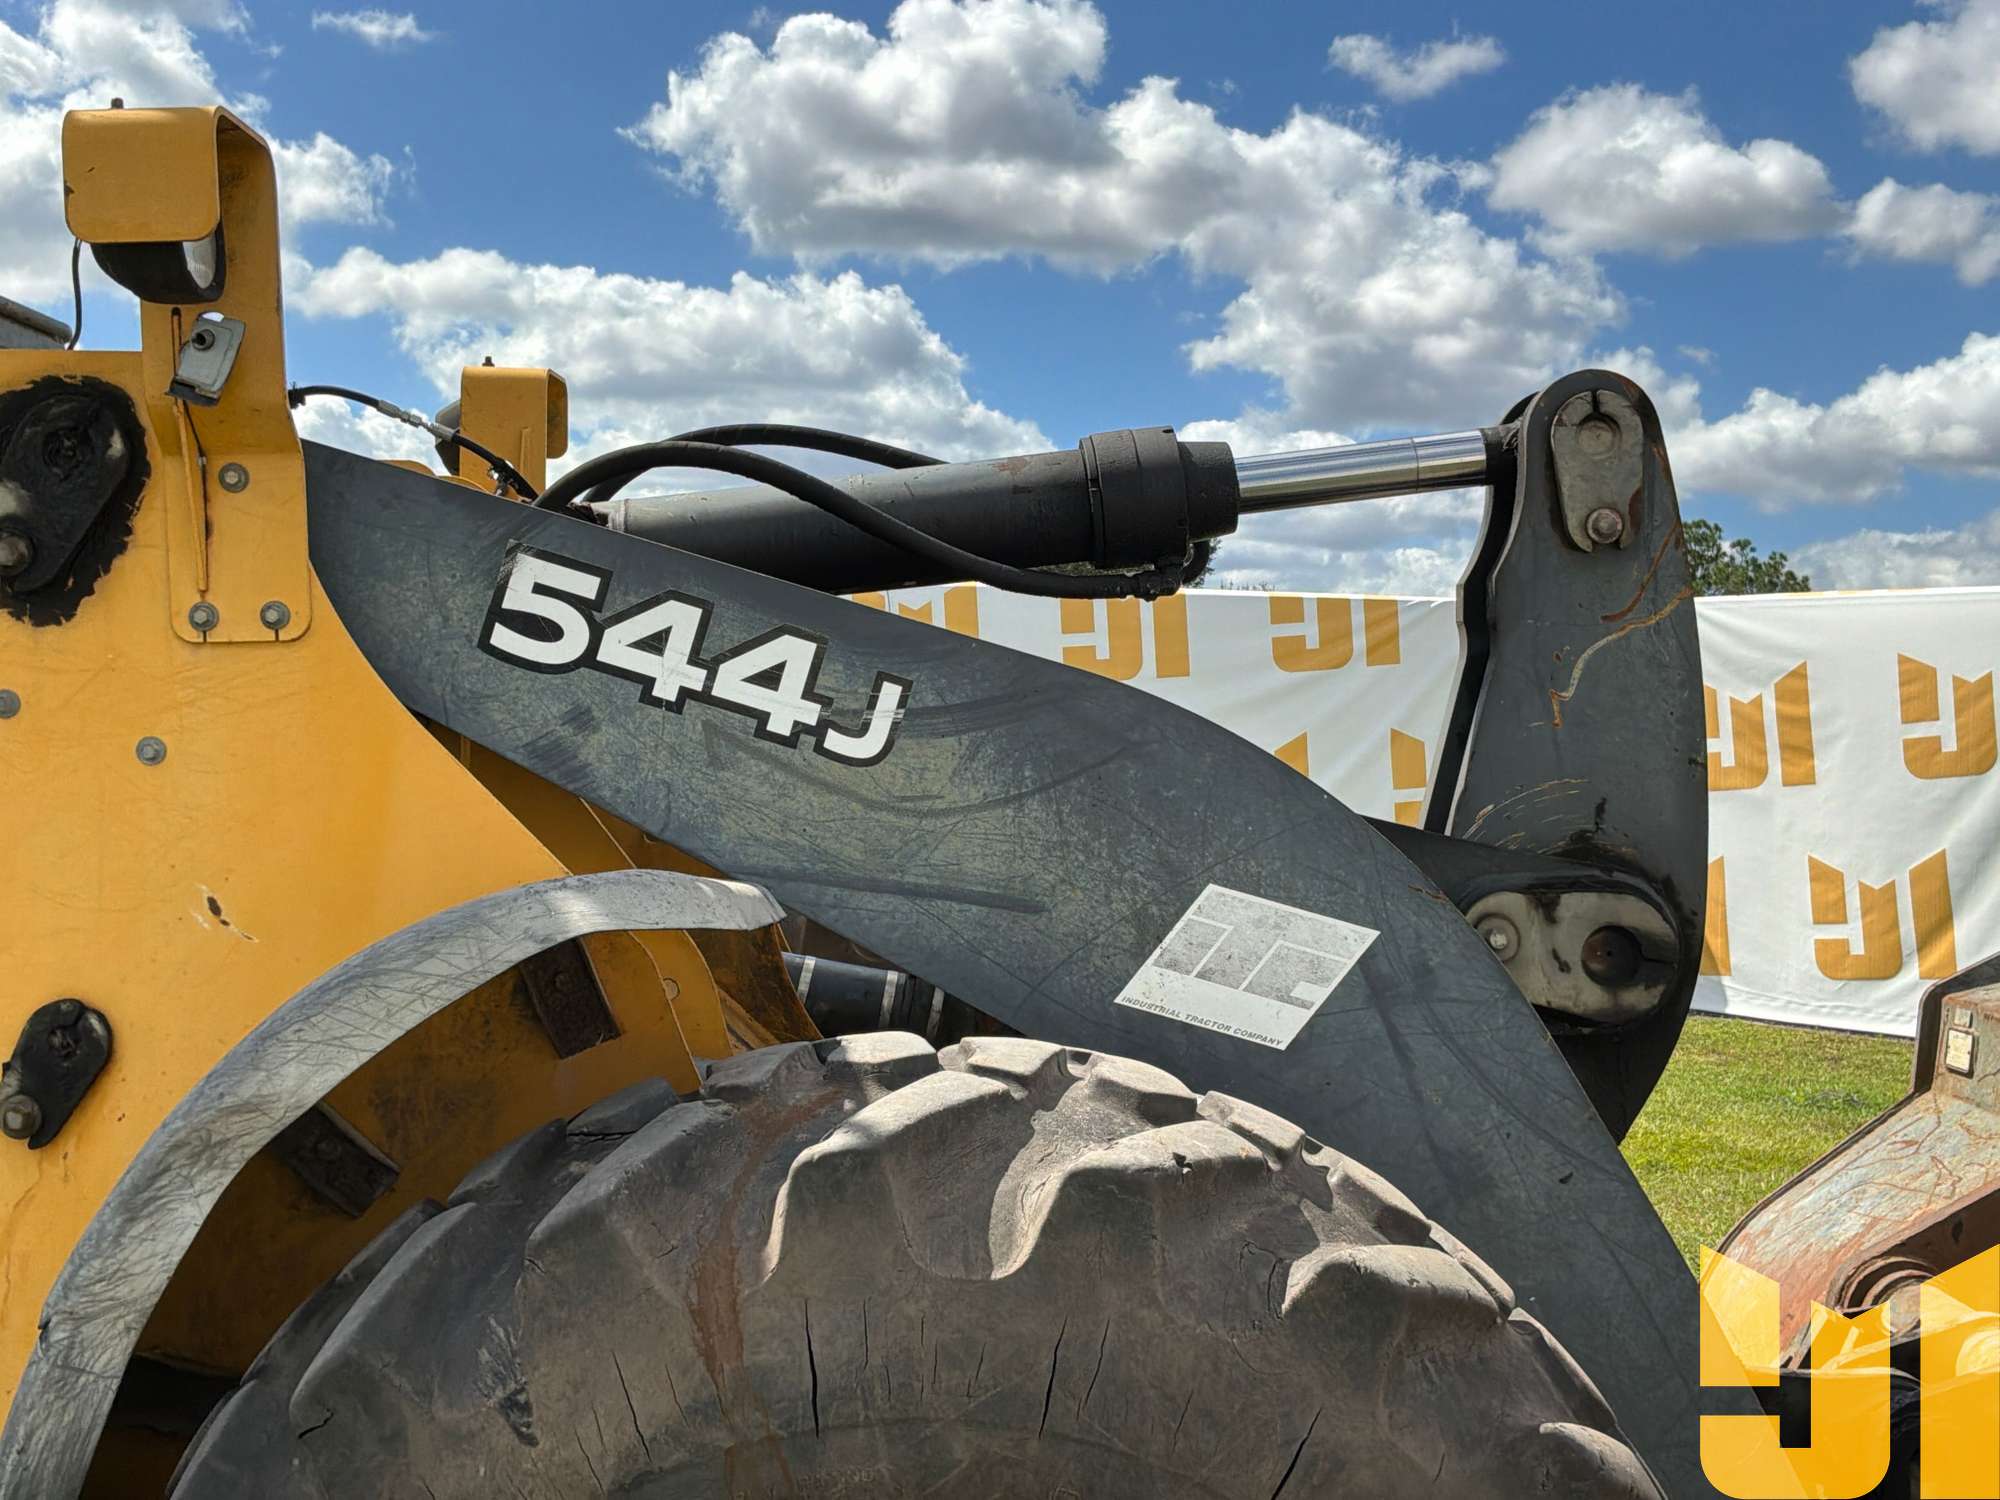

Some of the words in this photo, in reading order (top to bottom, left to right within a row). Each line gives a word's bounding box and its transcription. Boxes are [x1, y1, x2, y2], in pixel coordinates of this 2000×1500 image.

[489, 552, 903, 760] 544J
[1120, 995, 1182, 1019] INDUSTRIAL
[1184, 1013, 1233, 1034] TRACTOR
[1232, 1027, 1284, 1047] COMPANY
